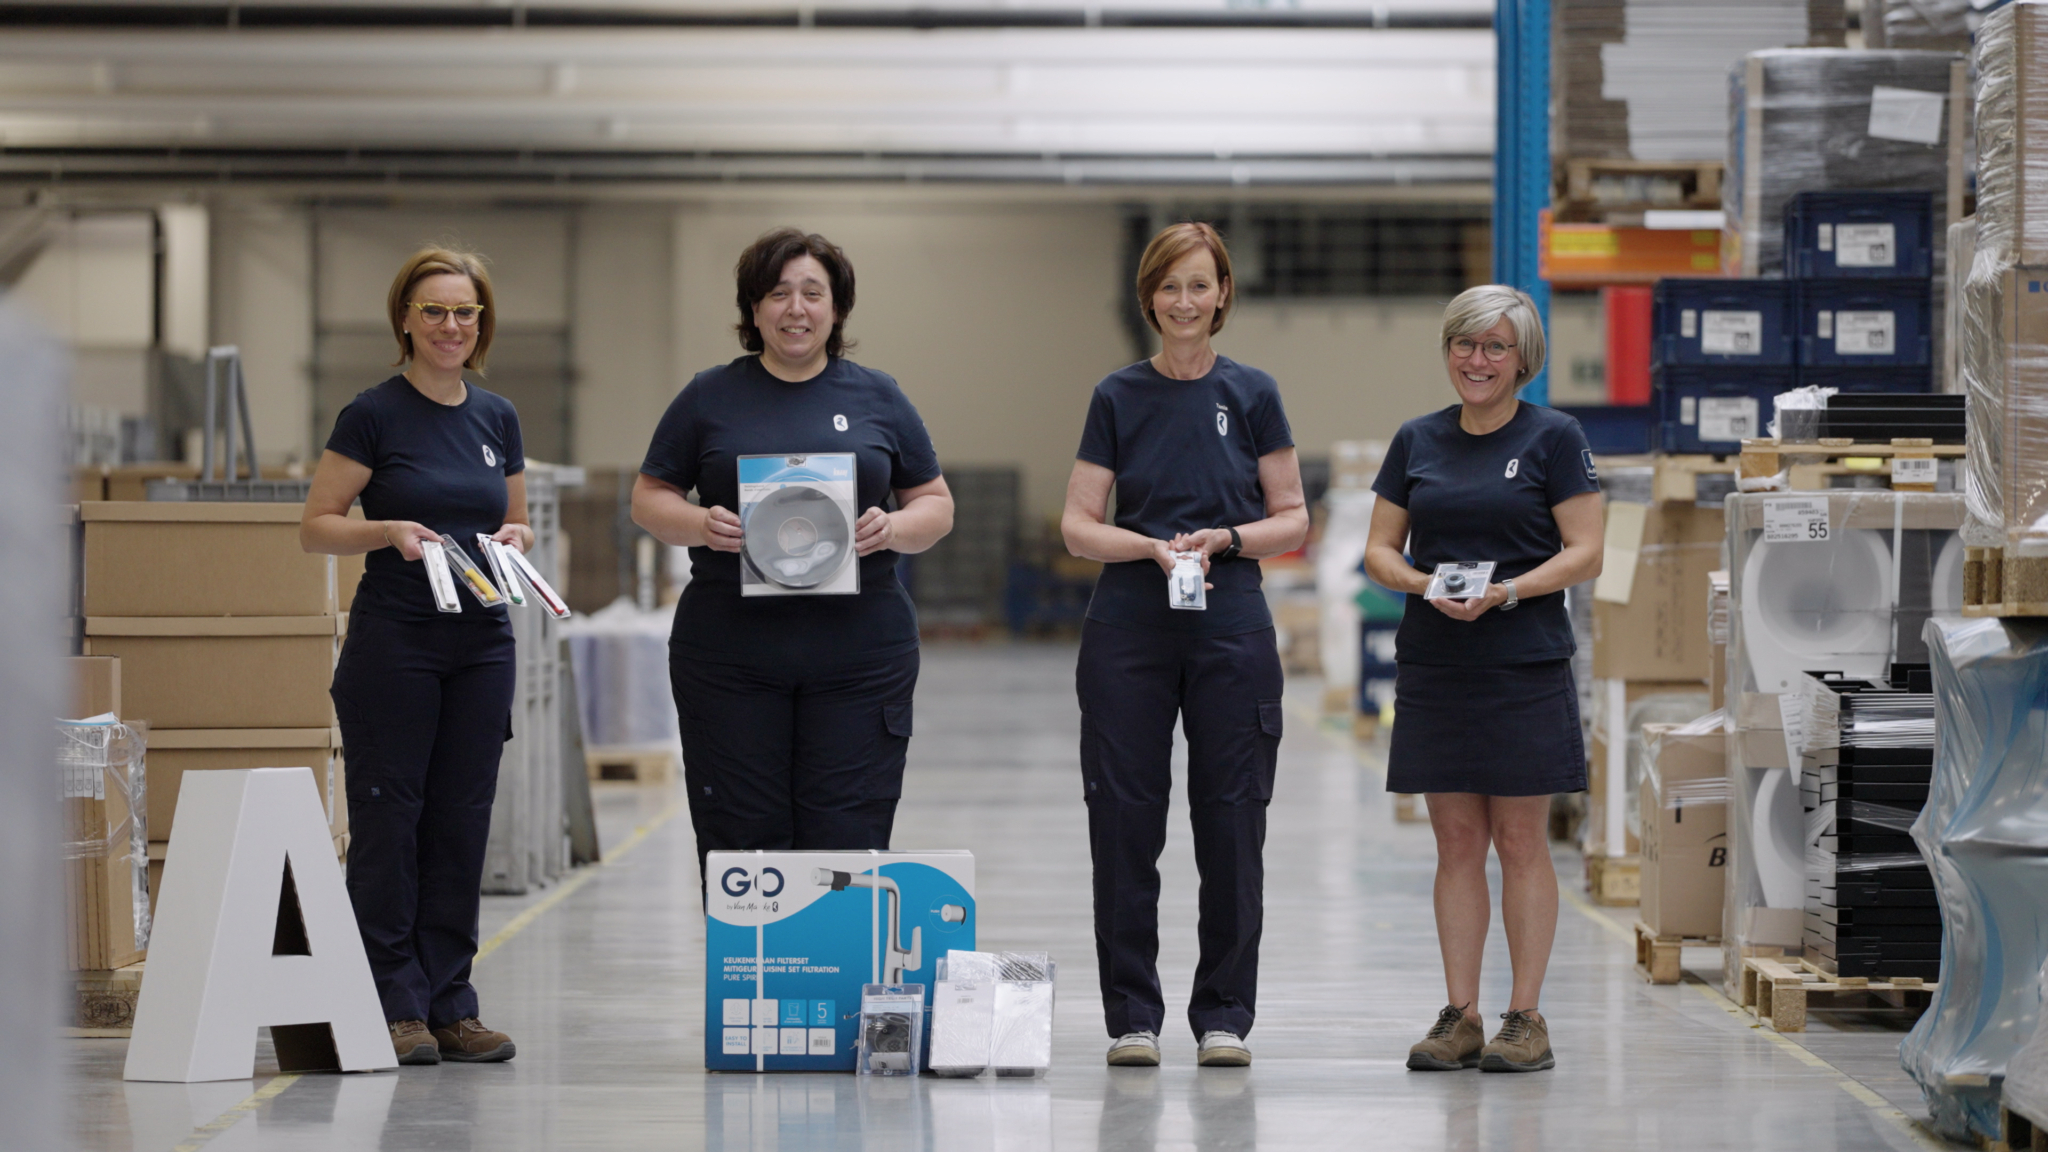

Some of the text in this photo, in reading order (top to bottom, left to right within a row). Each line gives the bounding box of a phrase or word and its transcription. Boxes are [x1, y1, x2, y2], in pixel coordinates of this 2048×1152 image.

[1808, 522, 1828, 539] 55
[721, 866, 785, 898] GO
[124, 767, 398, 1084] A
[762, 965, 786, 973] UISINE
[776, 957, 809, 965] FILTERSET
[817, 1002, 828, 1019] 5
